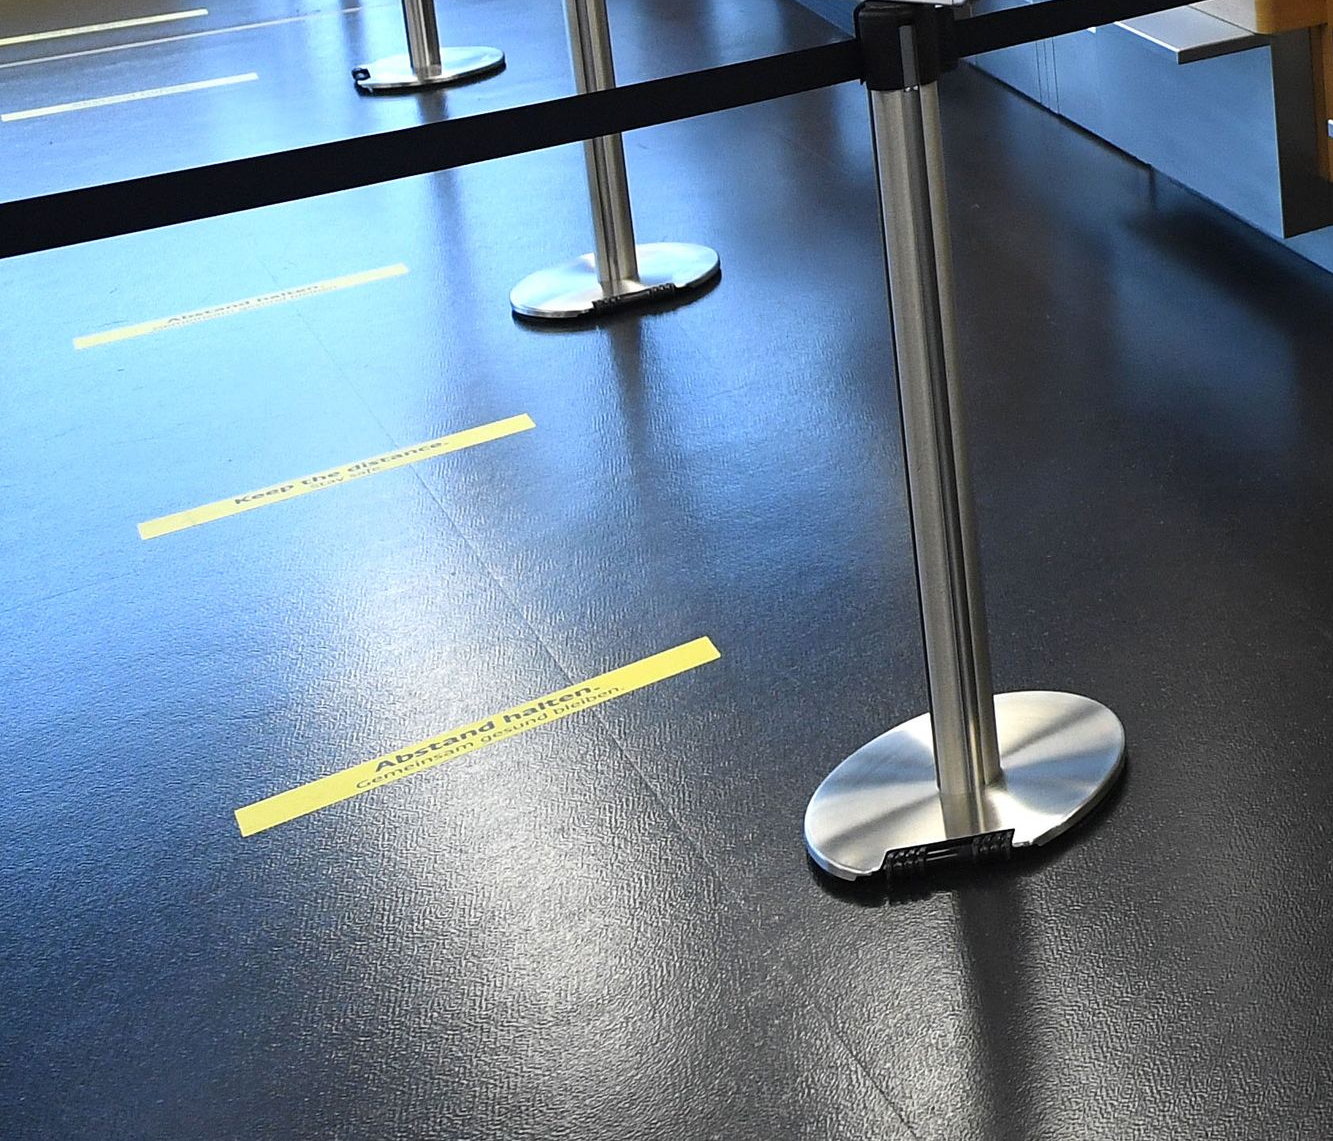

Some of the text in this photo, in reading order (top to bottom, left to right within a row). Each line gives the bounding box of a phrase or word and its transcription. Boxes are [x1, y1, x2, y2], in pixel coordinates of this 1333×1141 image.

[235, 441, 449, 505] Keep the distance.
[356, 740, 475, 790] Gemeinsam
[480, 712, 550, 744] gesund
[375, 686, 600, 773] Abstand halten.
